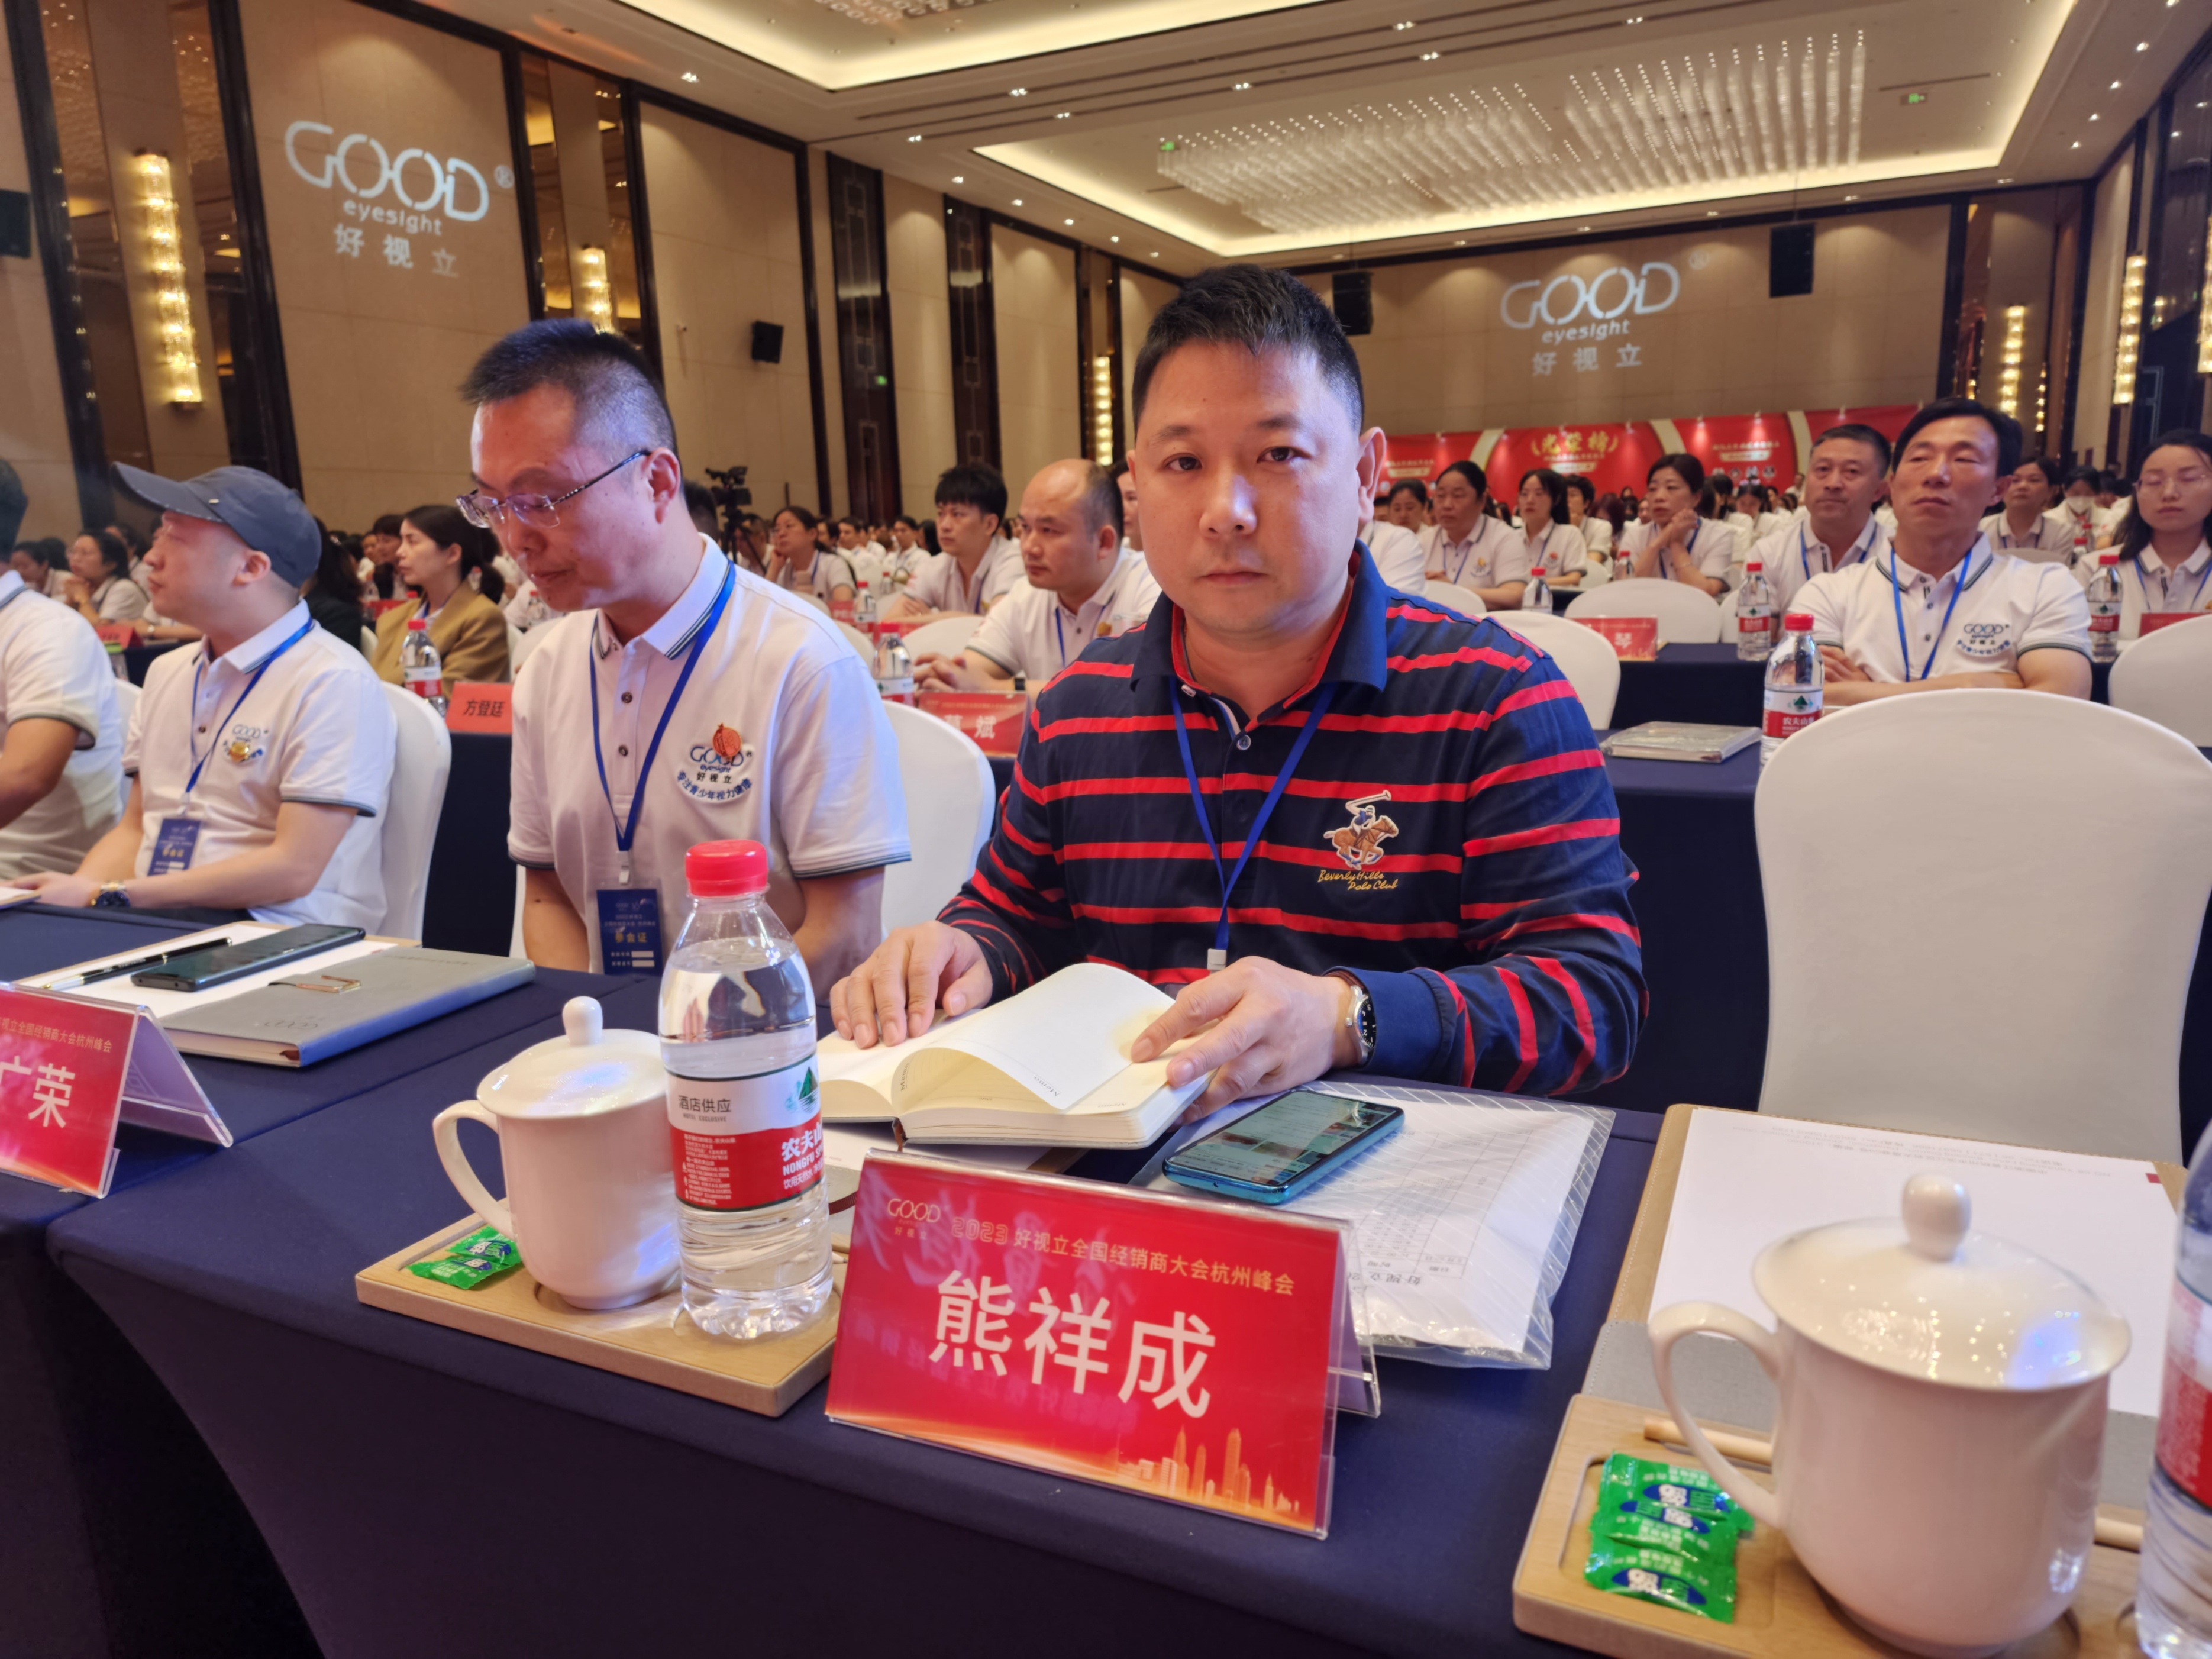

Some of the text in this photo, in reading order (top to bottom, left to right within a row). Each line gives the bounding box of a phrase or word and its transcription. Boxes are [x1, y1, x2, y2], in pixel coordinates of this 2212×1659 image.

[285, 120, 489, 222] GOOD
[343, 198, 443, 236] eyesight
[334, 223, 460, 278] 好视立
[1500, 261, 1681, 330] GOOD
[1541, 318, 1631, 346] eyesight
[1532, 343, 1642, 376] 好视立
[1964, 623, 2004, 634] GOOD
[463, 698, 505, 718] 方登廷
[700, 764, 731, 773] eyesight
[1317, 869, 1384, 883] Beverly Hills
[1348, 879, 1399, 891] Polo Club
[900, 1062, 909, 1092] Memo
[1033, 1076, 1060, 1097] Memo
[0, 1054, 76, 1128] 广荣
[678, 1095, 732, 1113] 酒店供应
[683, 1112, 727, 1123] HOTEL EXCLUSIVE
[782, 1151, 815, 1176] NONGFU
[783, 1168, 813, 1190] 饮用天然水
[887, 1198, 941, 1224] GOOD
[894, 1226, 928, 1241] 好视立
[951, 1216, 1009, 1246] 2023
[1013, 1227, 1296, 1296] 好视立全国经销商大会杭州峰会
[928, 1269, 1216, 1419] 熊祥成
